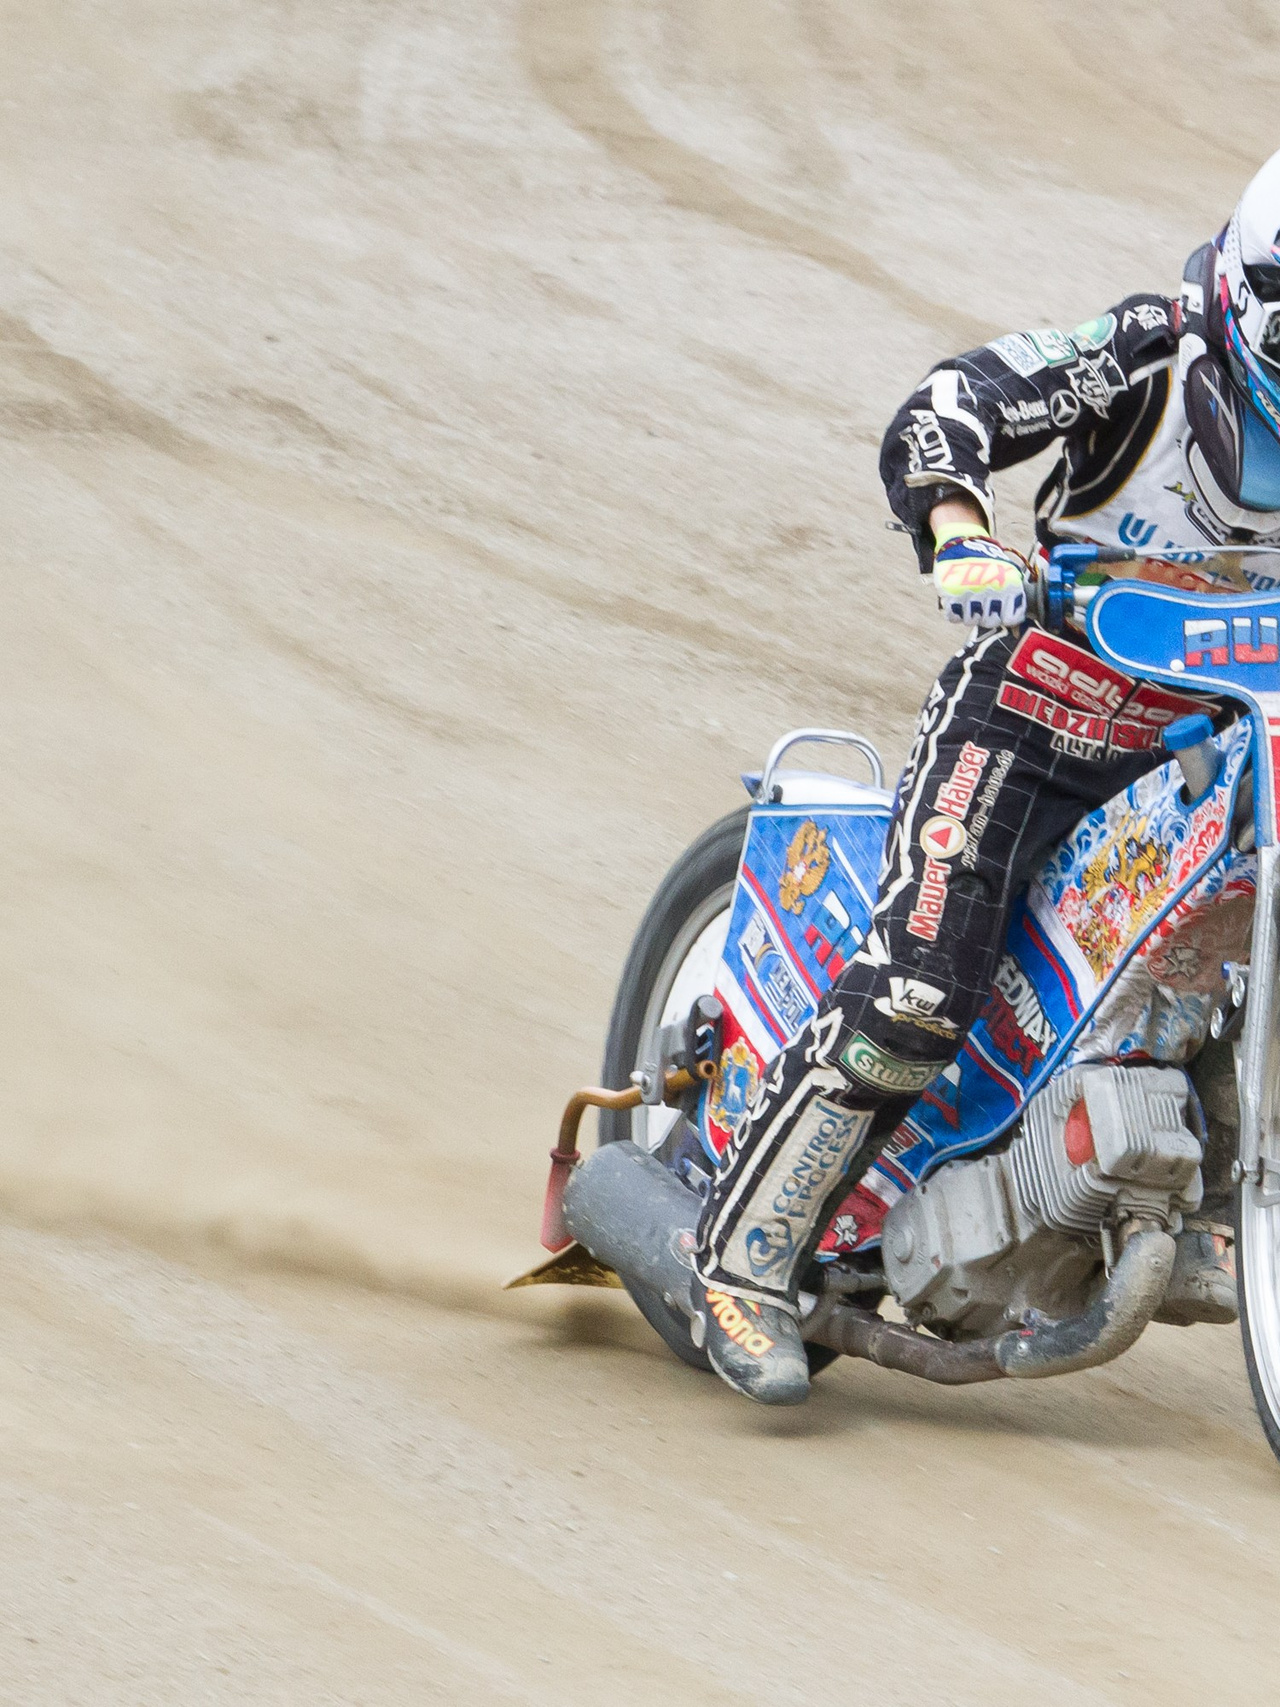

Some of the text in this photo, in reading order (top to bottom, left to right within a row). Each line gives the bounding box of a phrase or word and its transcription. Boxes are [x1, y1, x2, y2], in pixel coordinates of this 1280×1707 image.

[942, 562, 1013, 588] FOX
[906, 740, 990, 942] Mauer Häuser
